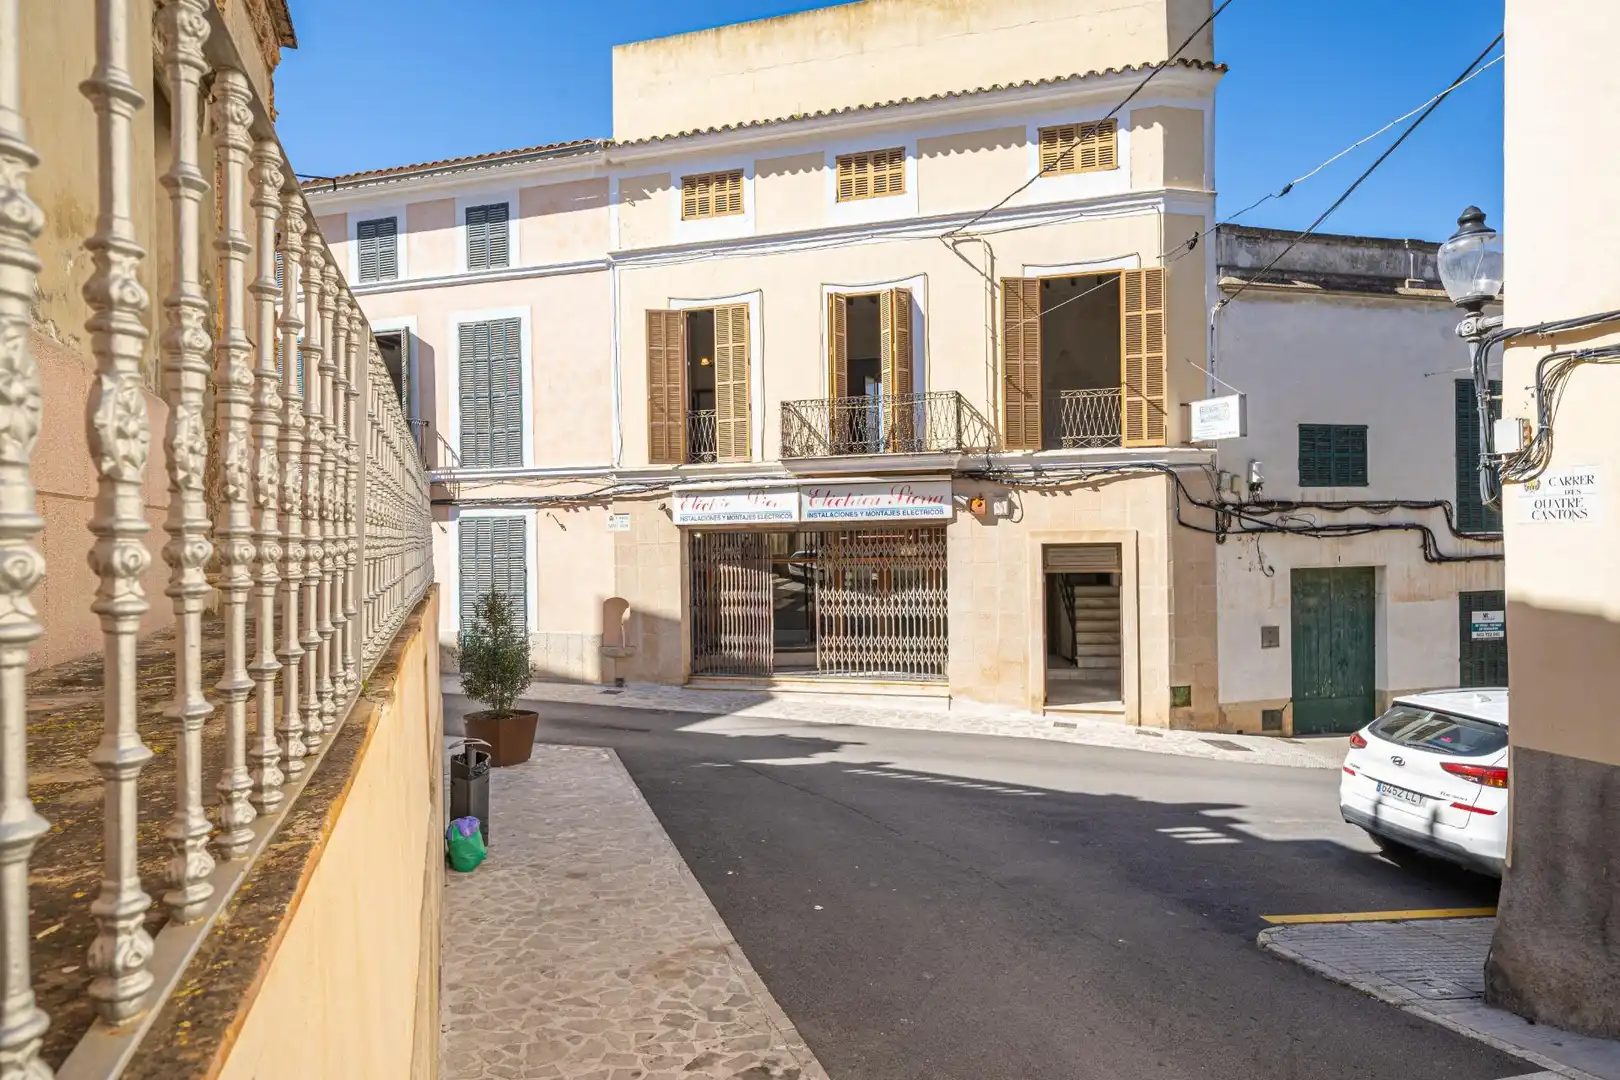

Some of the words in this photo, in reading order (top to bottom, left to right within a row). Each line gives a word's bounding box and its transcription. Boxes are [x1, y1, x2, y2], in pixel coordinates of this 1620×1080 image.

[1548, 475, 1594, 486] CARRER
[1534, 497, 1583, 509] QUATRE
[807, 510, 858, 518] INSTALACIONES
[1531, 509, 1588, 520] CANTONS
